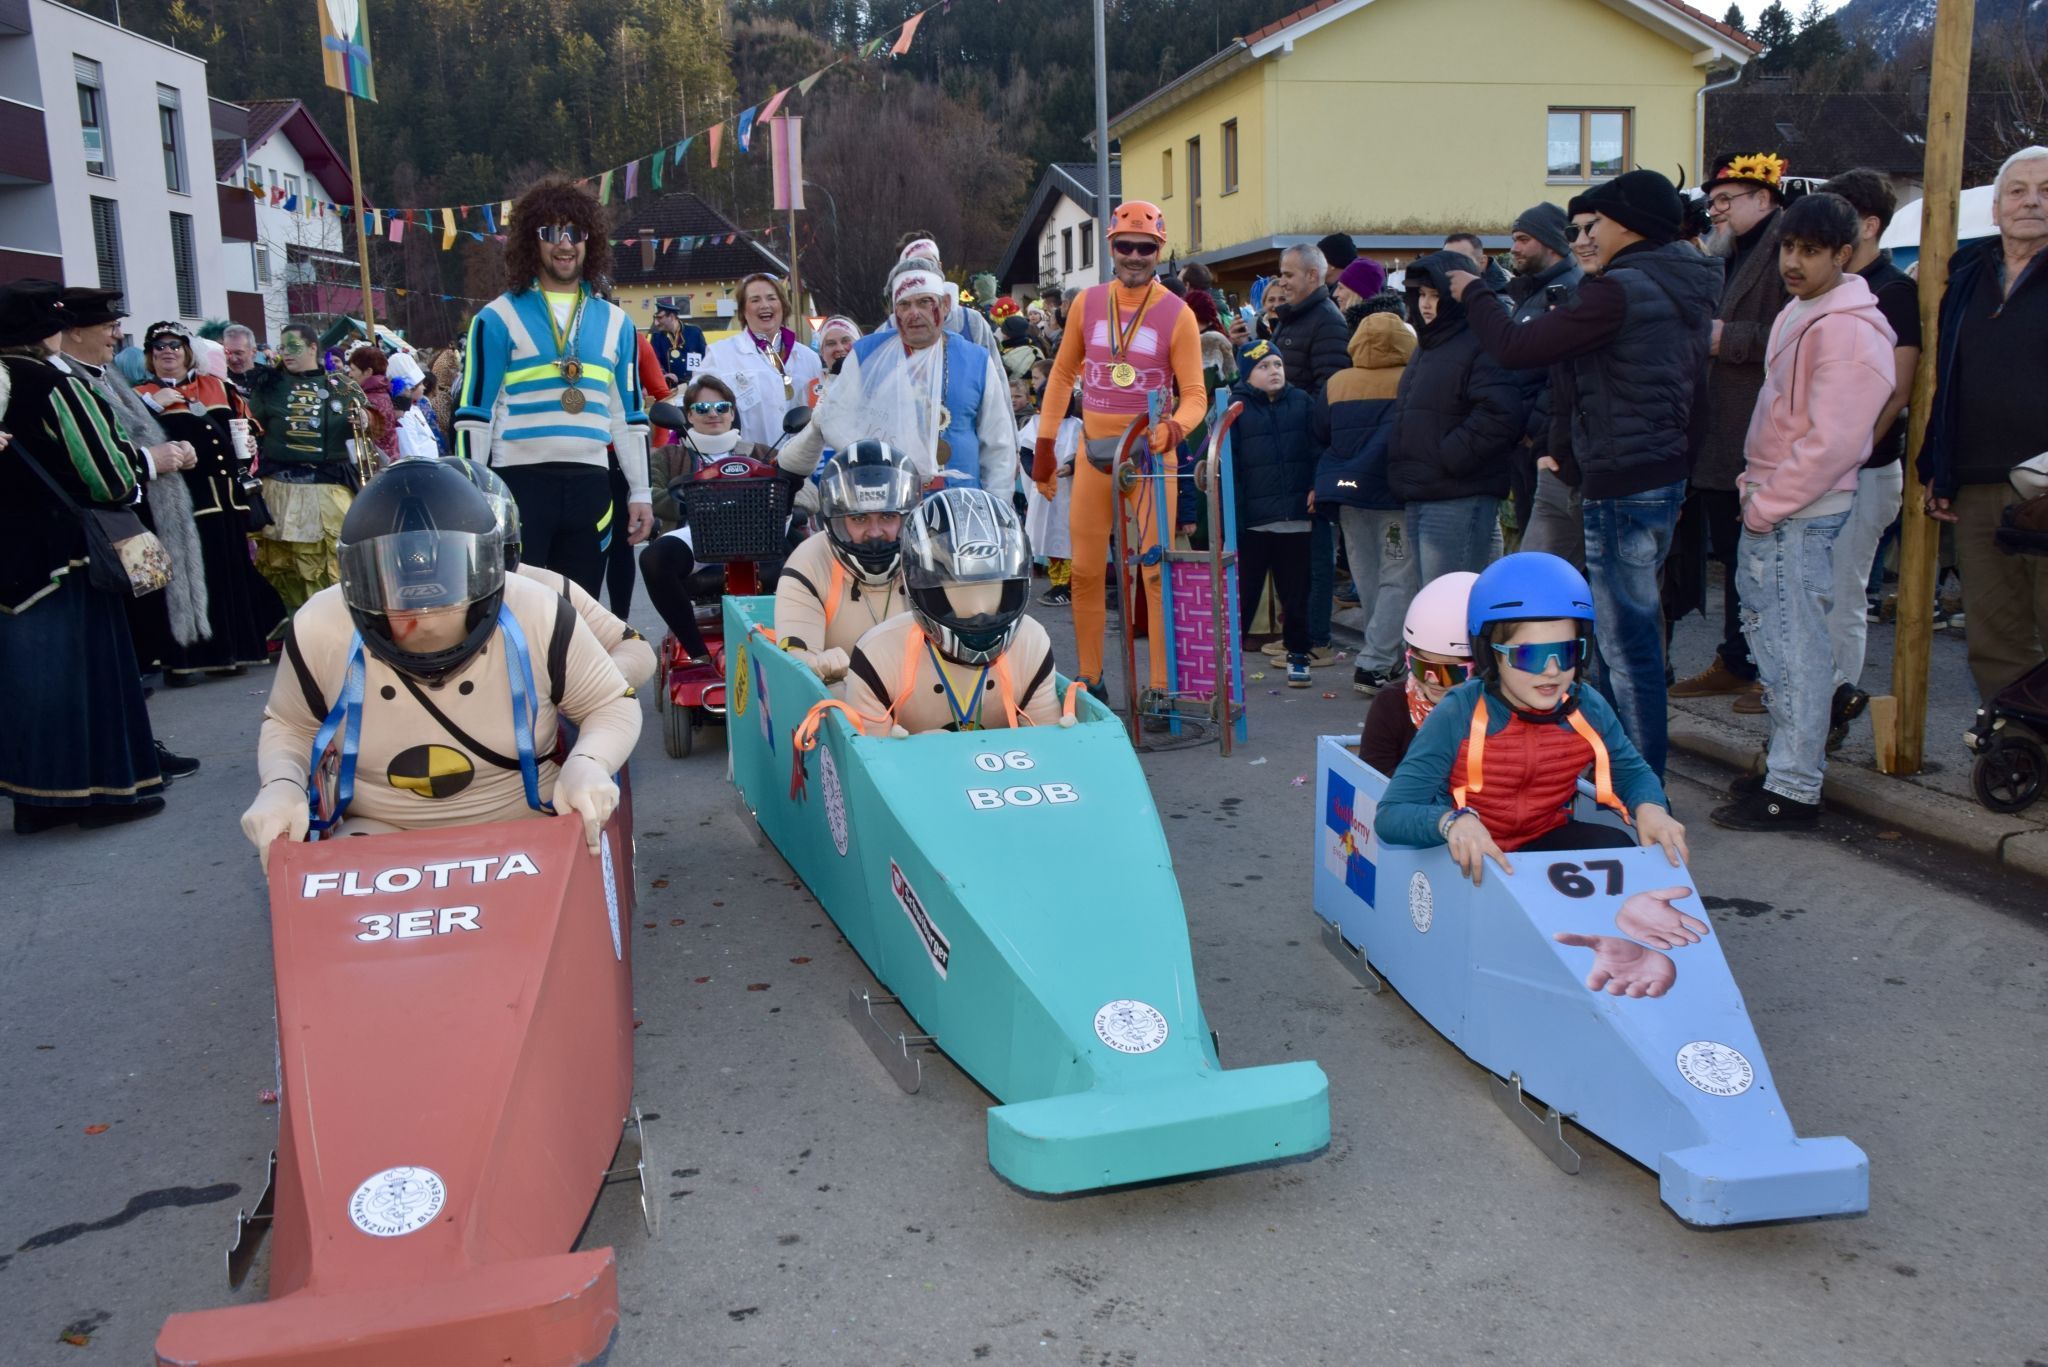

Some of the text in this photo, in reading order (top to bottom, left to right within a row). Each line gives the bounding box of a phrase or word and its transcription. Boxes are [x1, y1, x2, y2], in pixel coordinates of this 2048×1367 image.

[687, 356, 701, 368] 33
[975, 750, 1035, 773] 06
[966, 783, 1080, 811] BOB
[302, 853, 541, 899] FLOTTA
[1547, 859, 1624, 899] 67
[355, 904, 483, 943] 3ER
[1096, 1007, 1166, 1053] FUNKENZUNFT BLUDENZ
[1679, 1050, 1752, 1095] FUNKENZUNFT BLUDENZ
[353, 1176, 441, 1234] FUNKENZUNFT BLUDENZ
